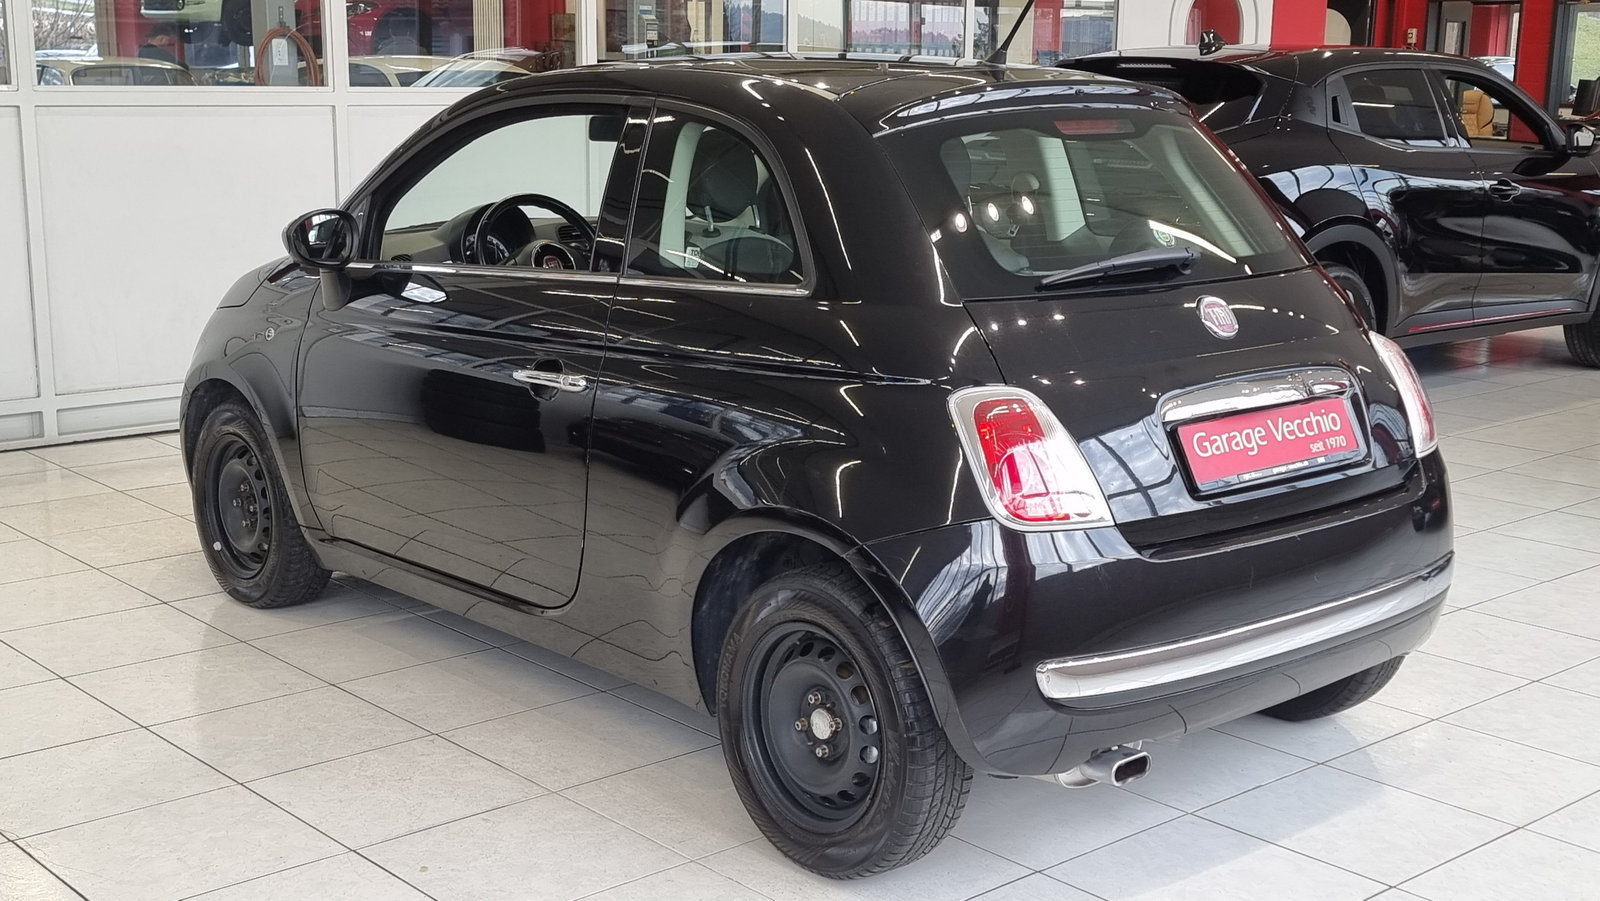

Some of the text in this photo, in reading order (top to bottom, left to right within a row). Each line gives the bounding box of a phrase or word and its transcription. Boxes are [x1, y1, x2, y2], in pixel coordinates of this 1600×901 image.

[1193, 409, 1341, 457] Garage Vecchio
[1309, 435, 1347, 453] seit 1970
[719, 632, 744, 709] YOKOHAMA
